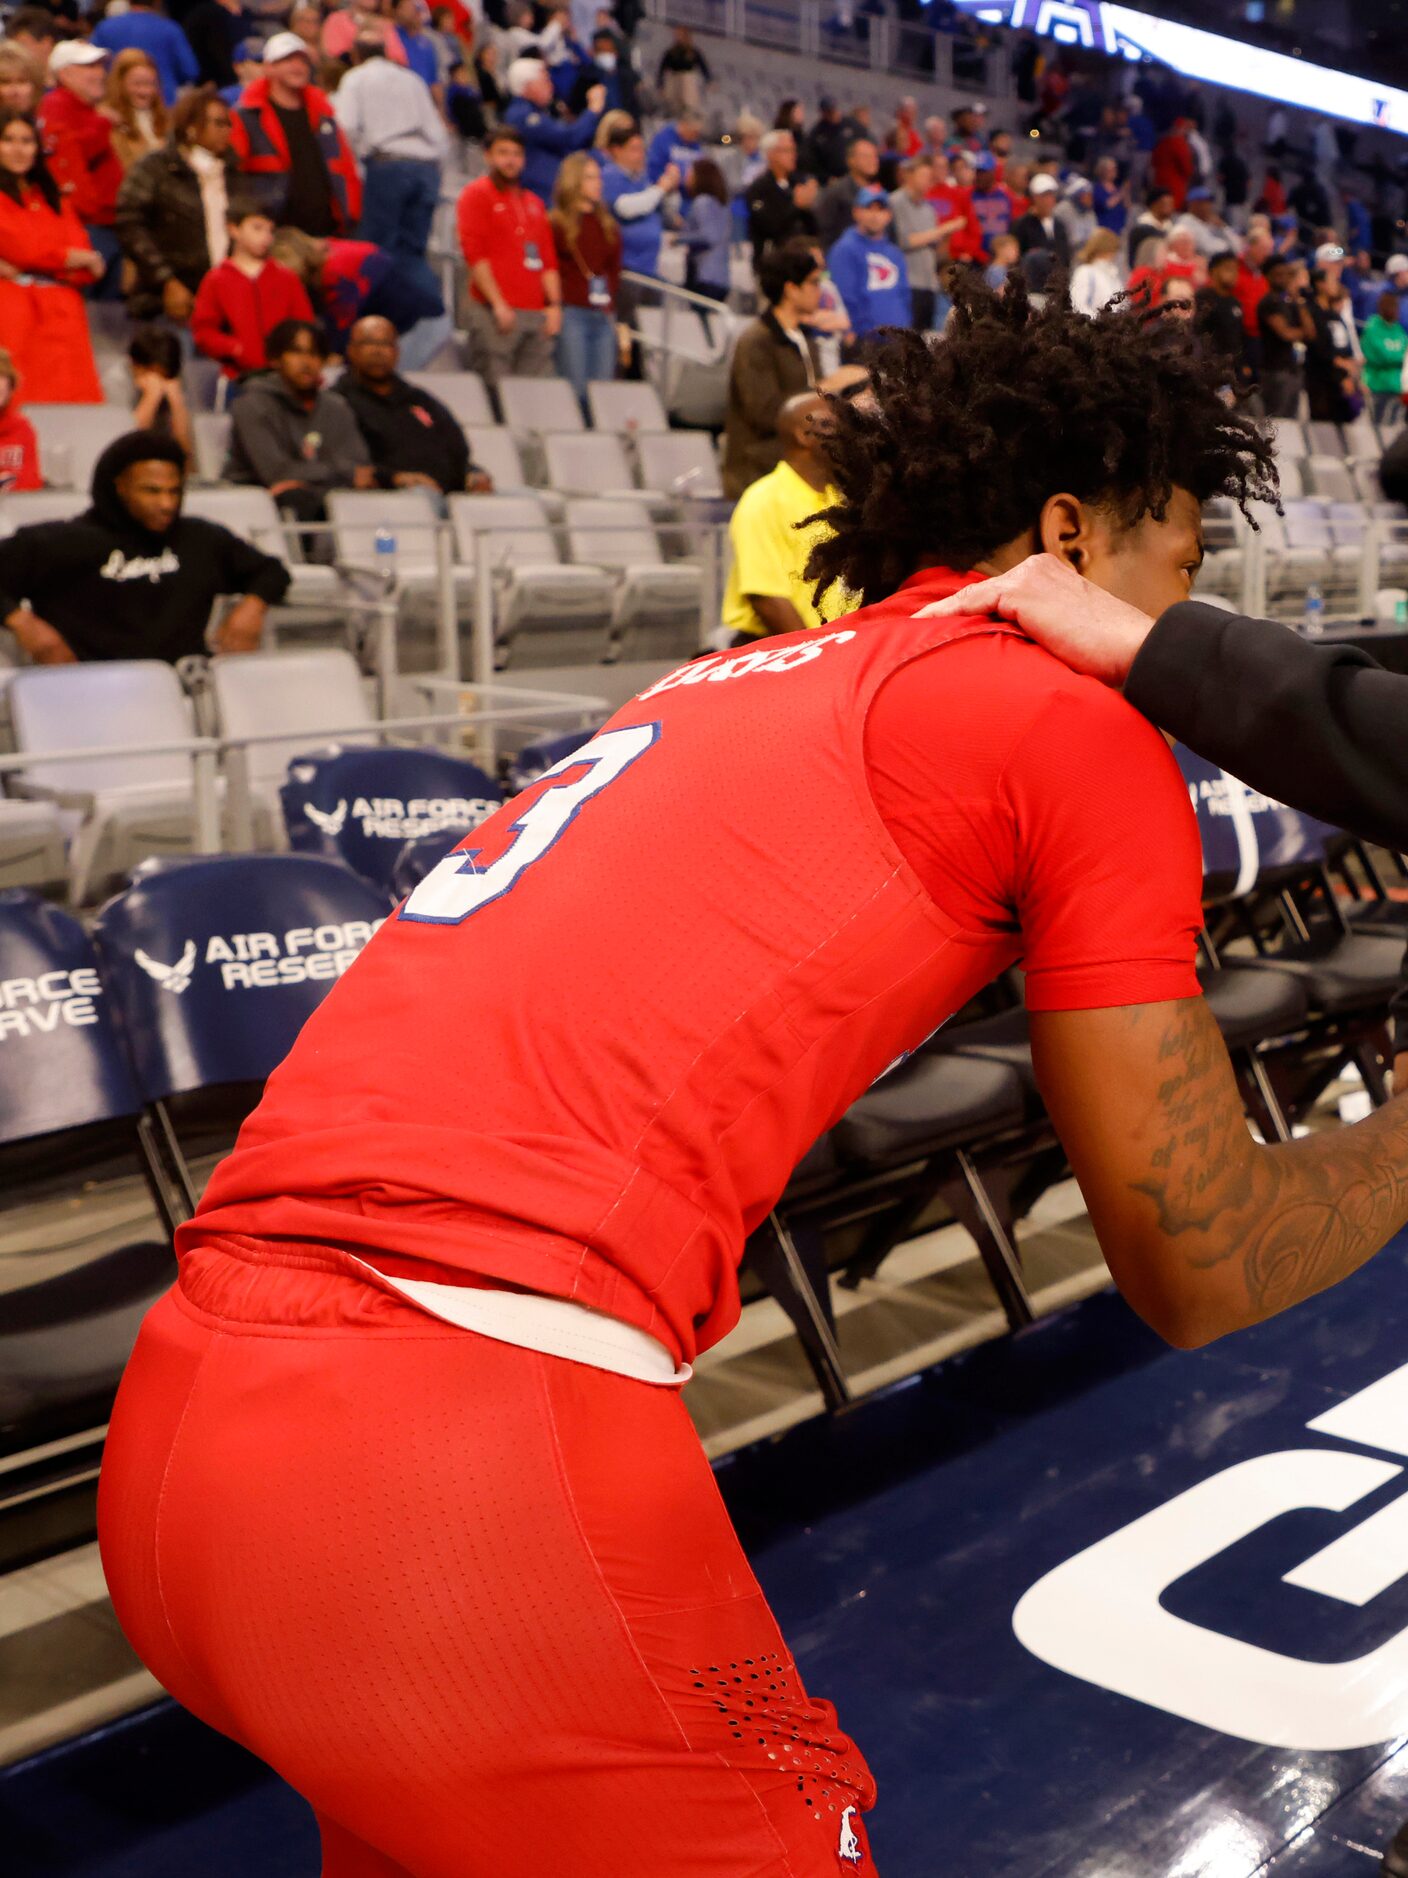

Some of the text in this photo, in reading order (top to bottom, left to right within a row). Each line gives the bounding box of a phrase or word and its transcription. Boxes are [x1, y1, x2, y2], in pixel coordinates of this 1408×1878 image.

[352, 798, 405, 818] AIR
[399, 720, 661, 925] 3
[205, 932, 280, 964] AIR
[0, 967, 104, 1010] RCE
